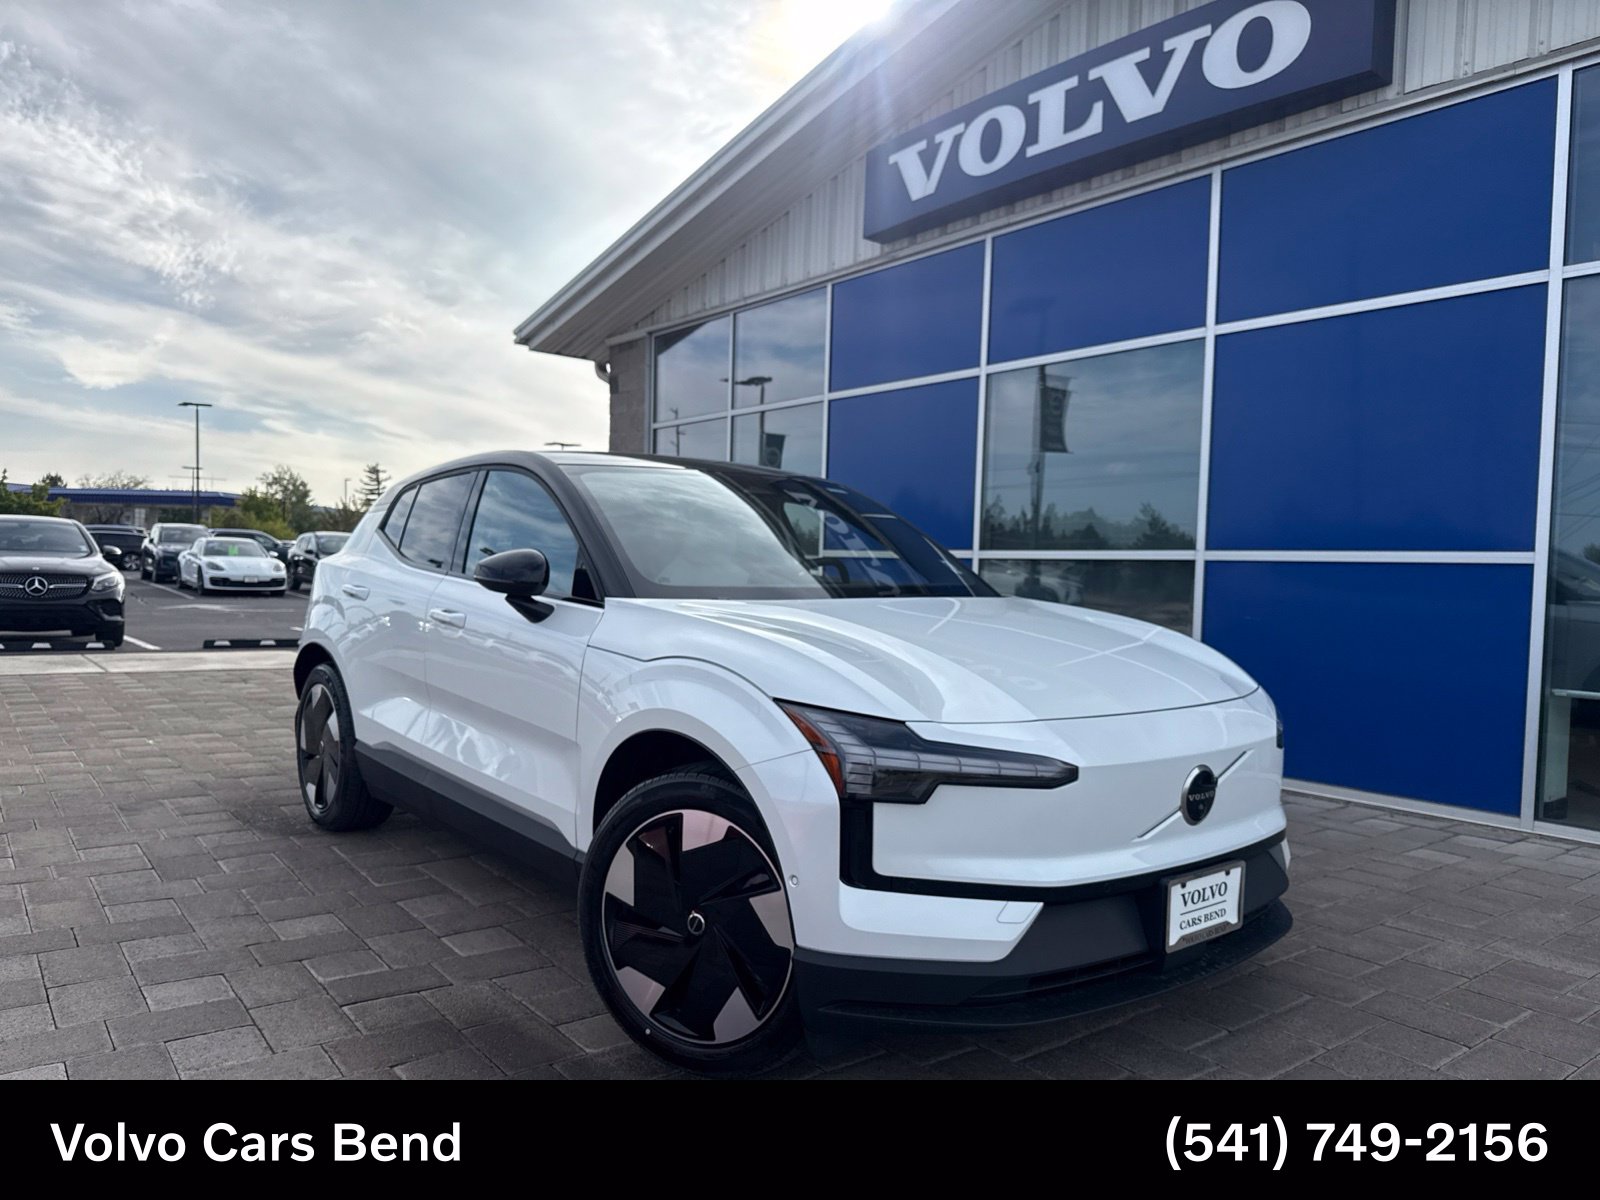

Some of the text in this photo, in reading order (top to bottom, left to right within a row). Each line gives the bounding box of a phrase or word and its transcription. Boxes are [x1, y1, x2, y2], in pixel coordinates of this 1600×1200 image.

[888, 0, 1312, 202] VOLVO
[1188, 790, 1216, 802] VOLVO
[1180, 881, 1228, 908] VOLVO
[1179, 908, 1227, 930] CARS BEND
